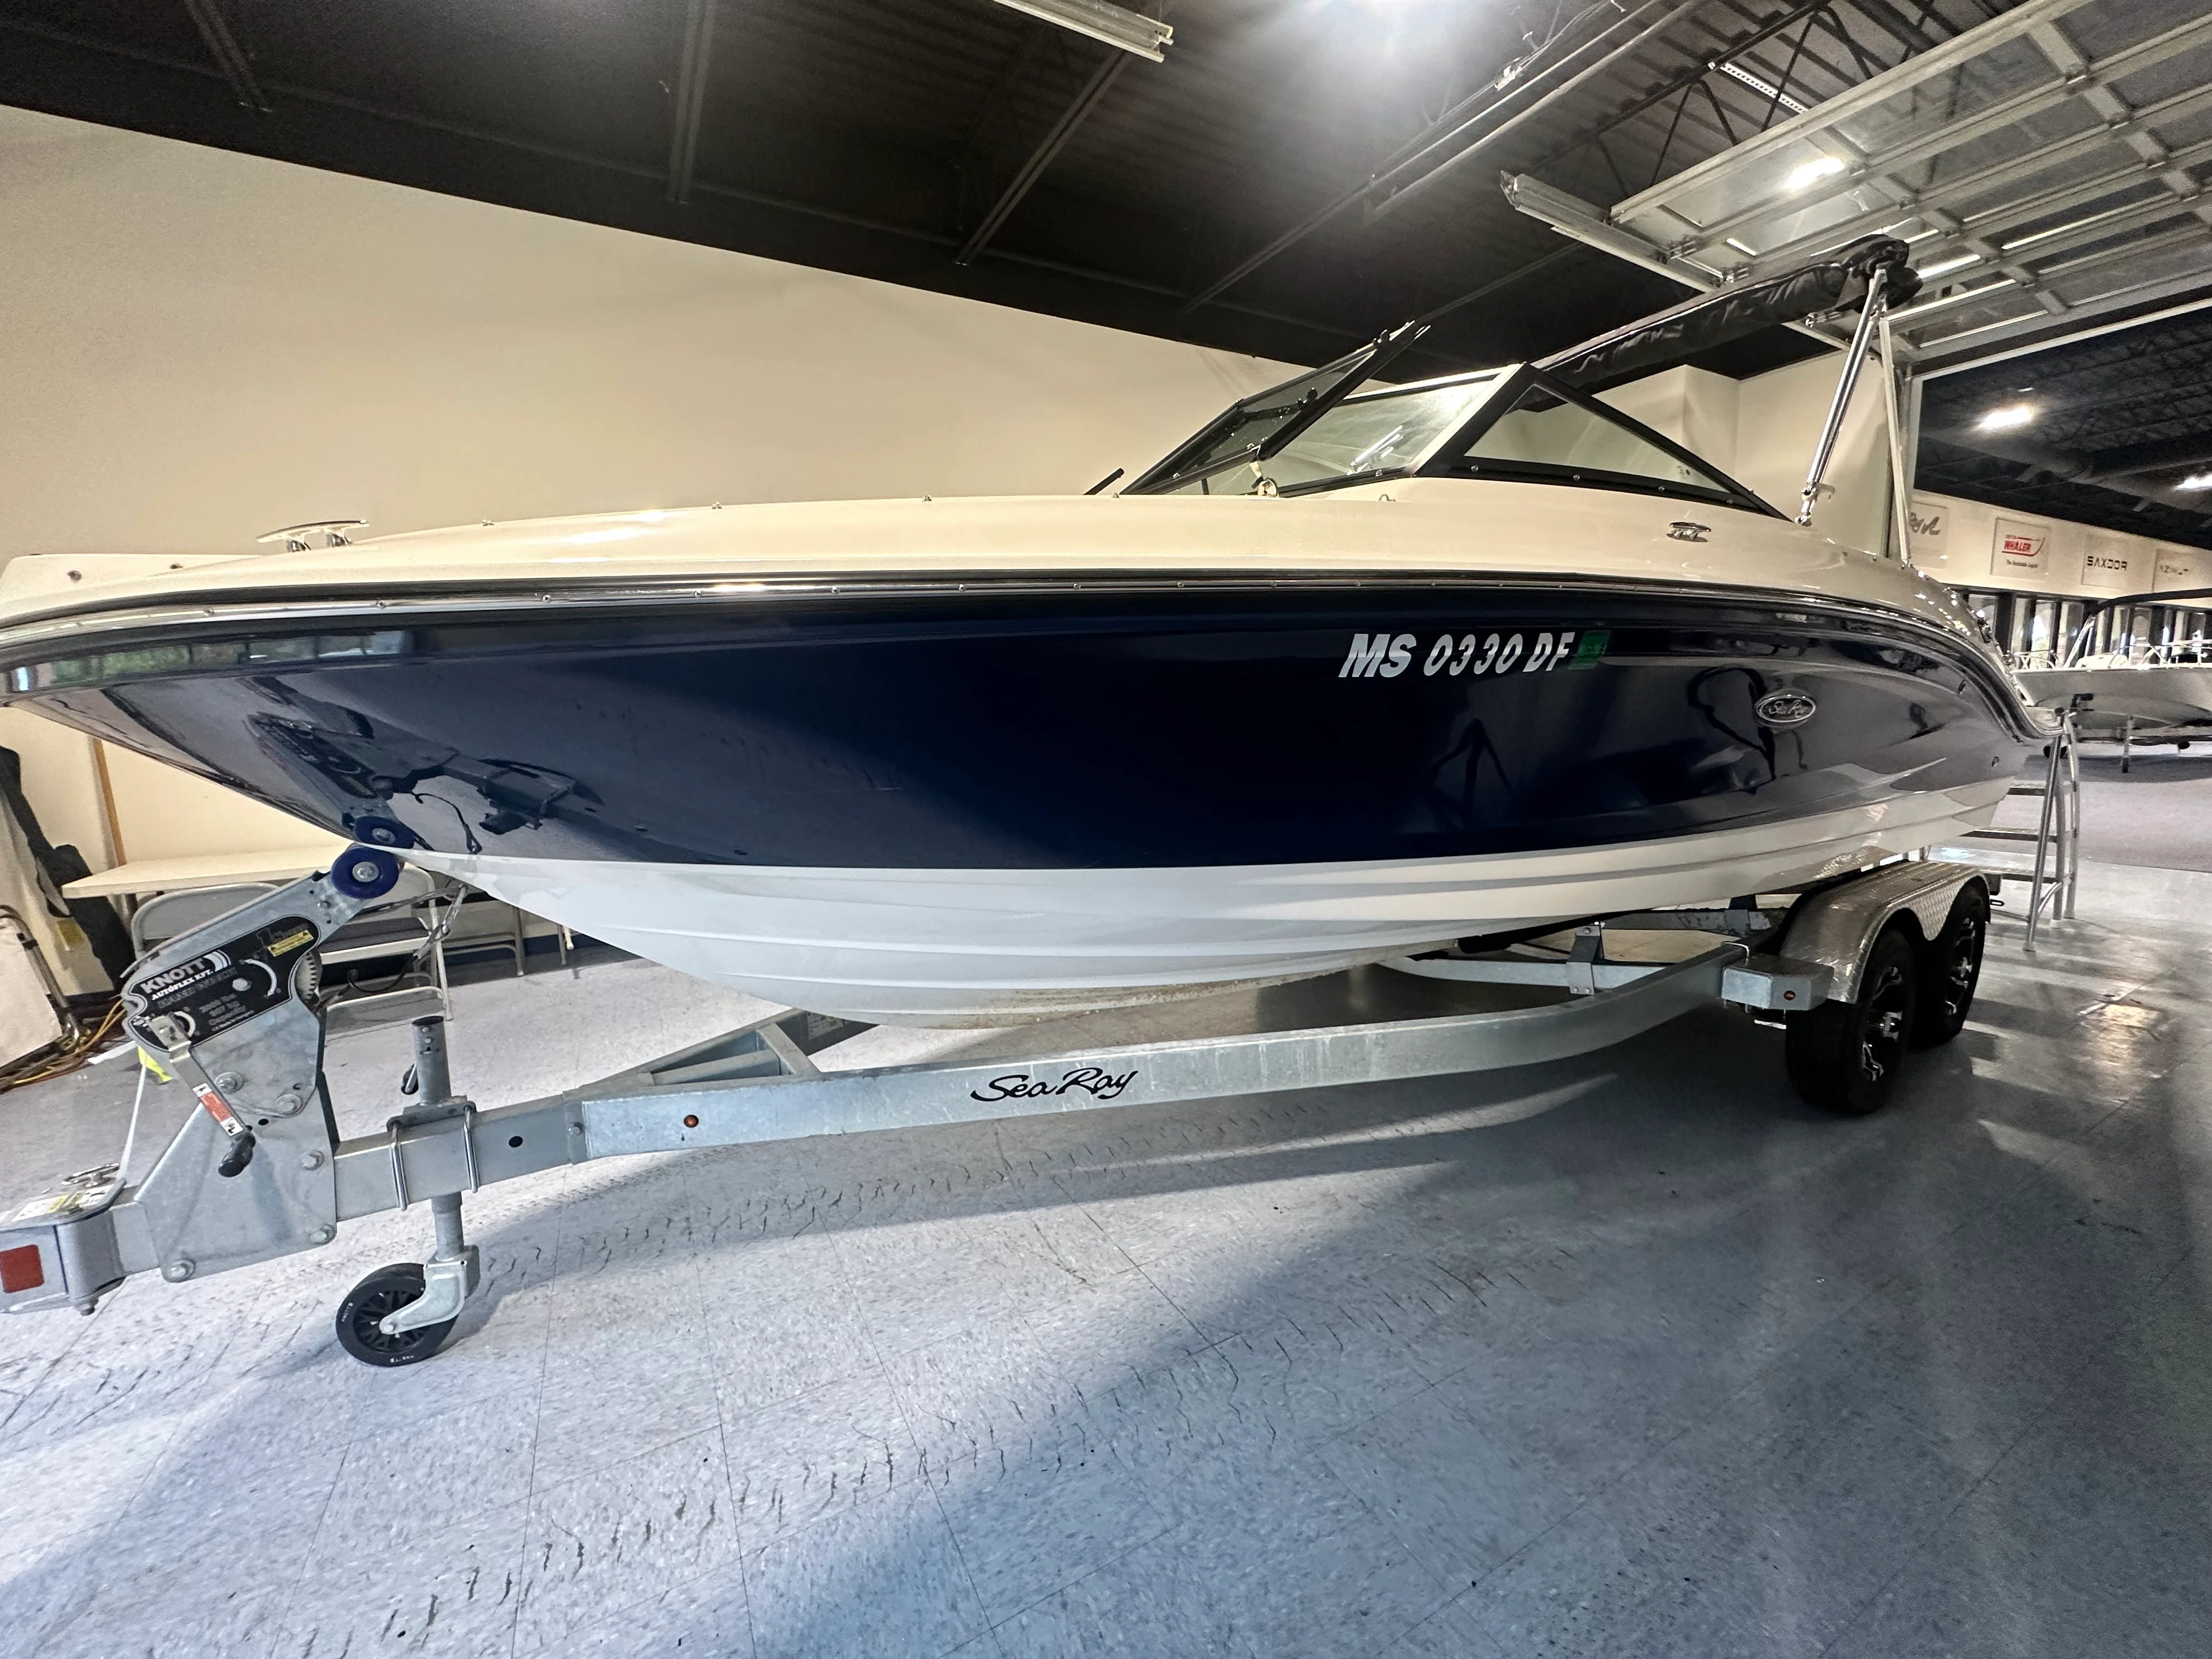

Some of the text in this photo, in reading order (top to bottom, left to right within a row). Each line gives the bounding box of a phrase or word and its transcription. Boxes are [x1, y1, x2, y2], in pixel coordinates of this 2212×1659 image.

[2004, 540, 2032, 552] WHALER
[2087, 556, 2128, 571] SAXDOR
[1338, 633, 1417, 678] MS
[1423, 633, 1523, 676] 0330
[1522, 631, 1576, 673] DF
[140, 958, 206, 994] KNOTT
[970, 1067, 1138, 1102] Sea Ray
